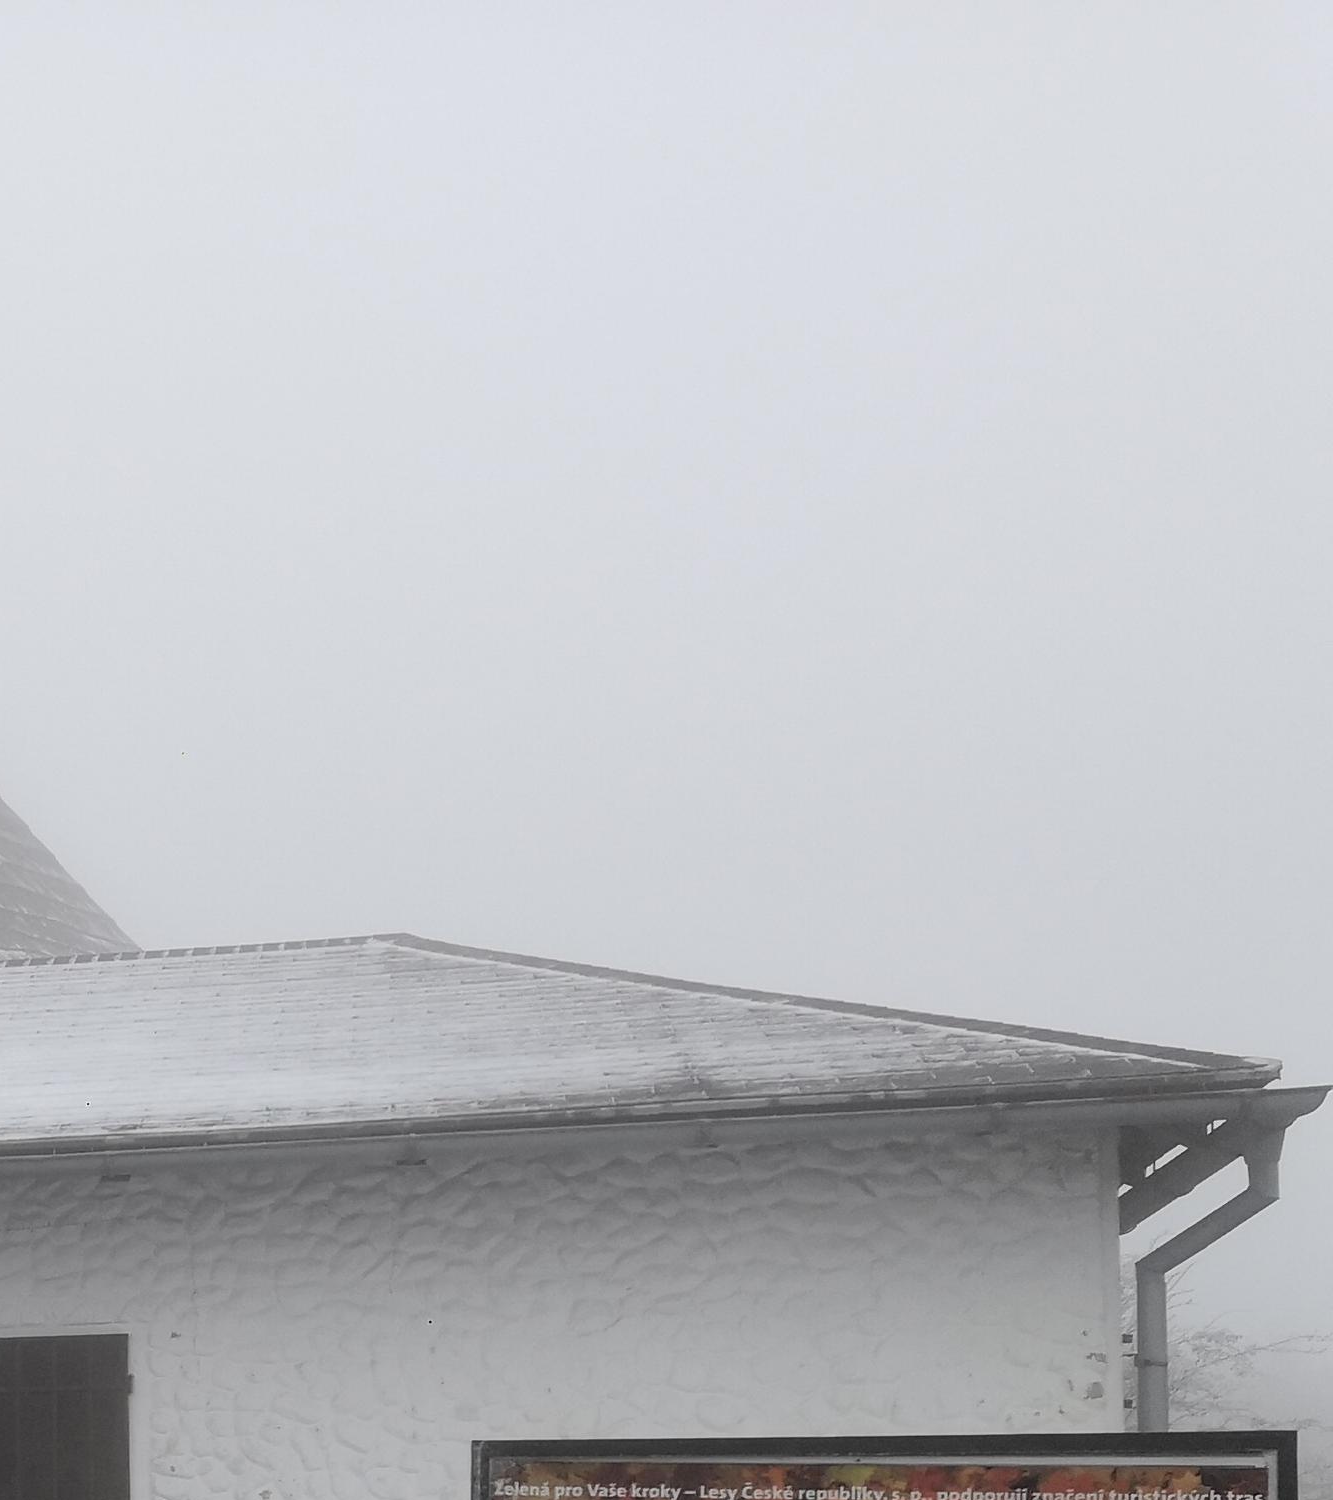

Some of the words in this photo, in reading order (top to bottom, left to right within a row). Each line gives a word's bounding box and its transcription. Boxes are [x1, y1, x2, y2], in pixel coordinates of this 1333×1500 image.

[494, 1480, 551, 1497] Zelená
[554, 1485, 583, 1500] pro
[587, 1482, 627, 1498] Vaše
[741, 1482, 794, 1500] České
